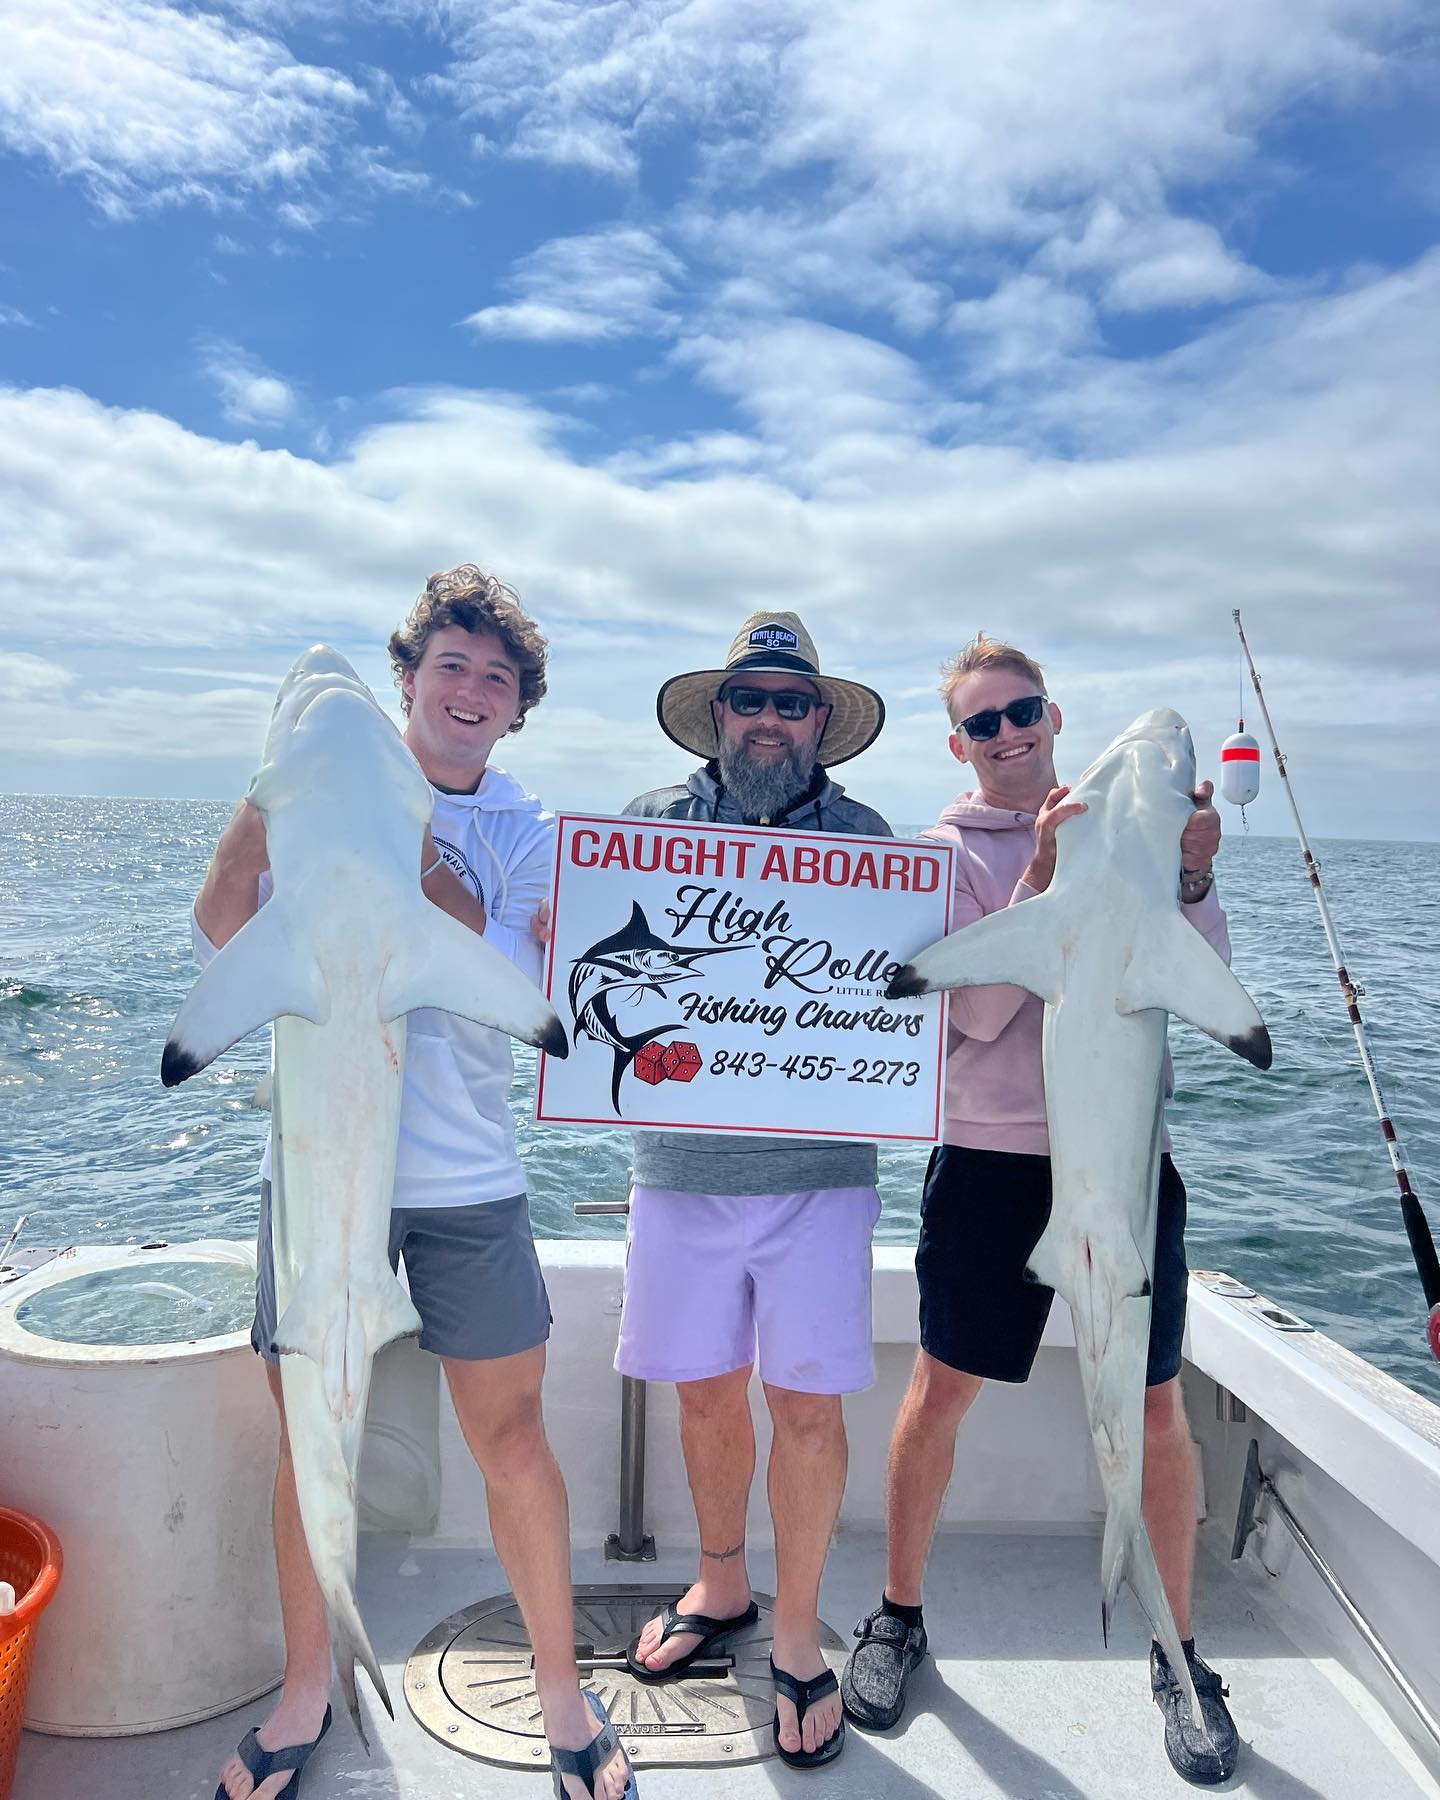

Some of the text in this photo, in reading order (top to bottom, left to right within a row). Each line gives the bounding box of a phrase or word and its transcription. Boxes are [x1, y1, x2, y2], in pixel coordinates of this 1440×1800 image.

[751, 631, 795, 643] MYRTLE BEACH
[766, 639, 780, 647] SC
[443, 852, 466, 877] WAVE
[571, 830, 941, 893] CAUGHT ABOARD
[665, 885, 793, 944] High
[761, 936, 902, 995] Rolle
[836, 987, 872, 996] LITTLE
[677, 992, 925, 1037] Fishing Charters
[708, 1050, 921, 1087] 843-455-2273
